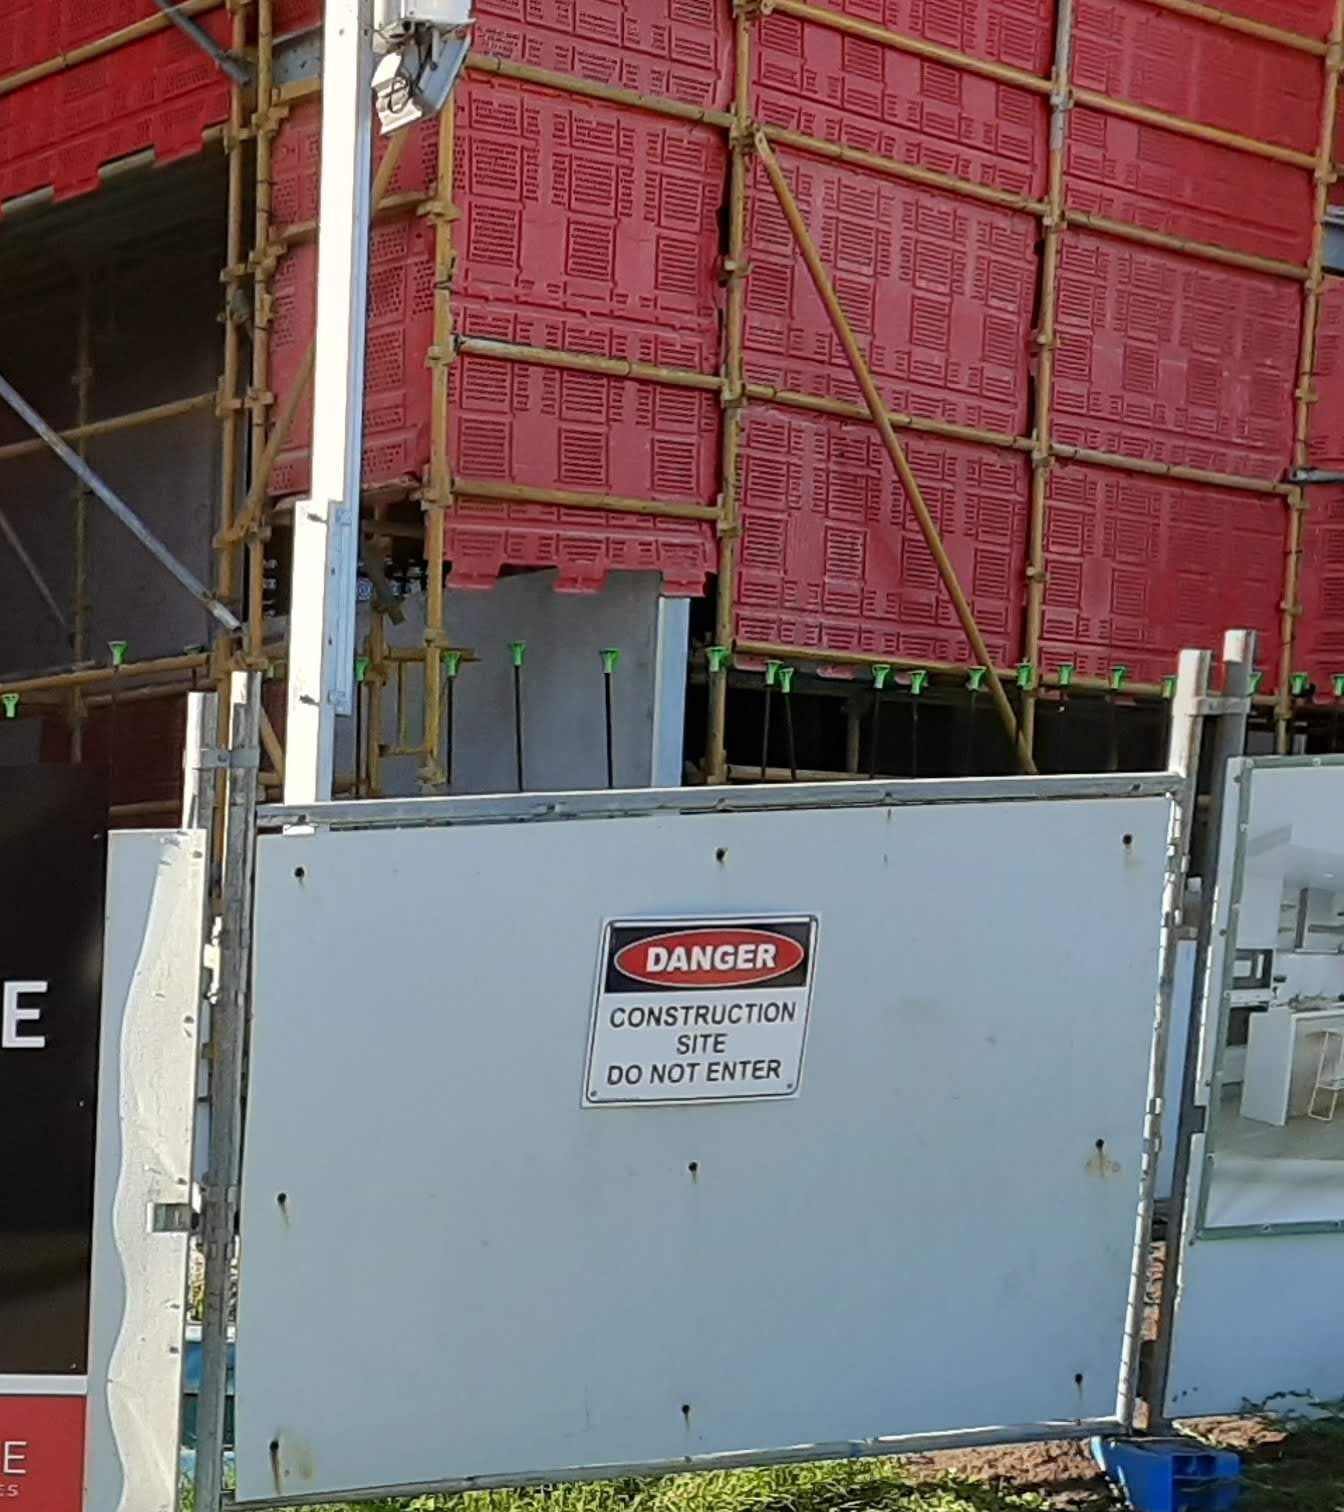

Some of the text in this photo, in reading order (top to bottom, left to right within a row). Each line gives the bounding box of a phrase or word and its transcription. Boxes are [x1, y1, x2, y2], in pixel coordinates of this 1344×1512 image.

[645, 943, 778, 973] DANGER
[609, 1001, 797, 1029] CONSTRUCTION
[676, 1032, 729, 1056] SITE
[606, 1058, 782, 1086] DO NOT ENTER
